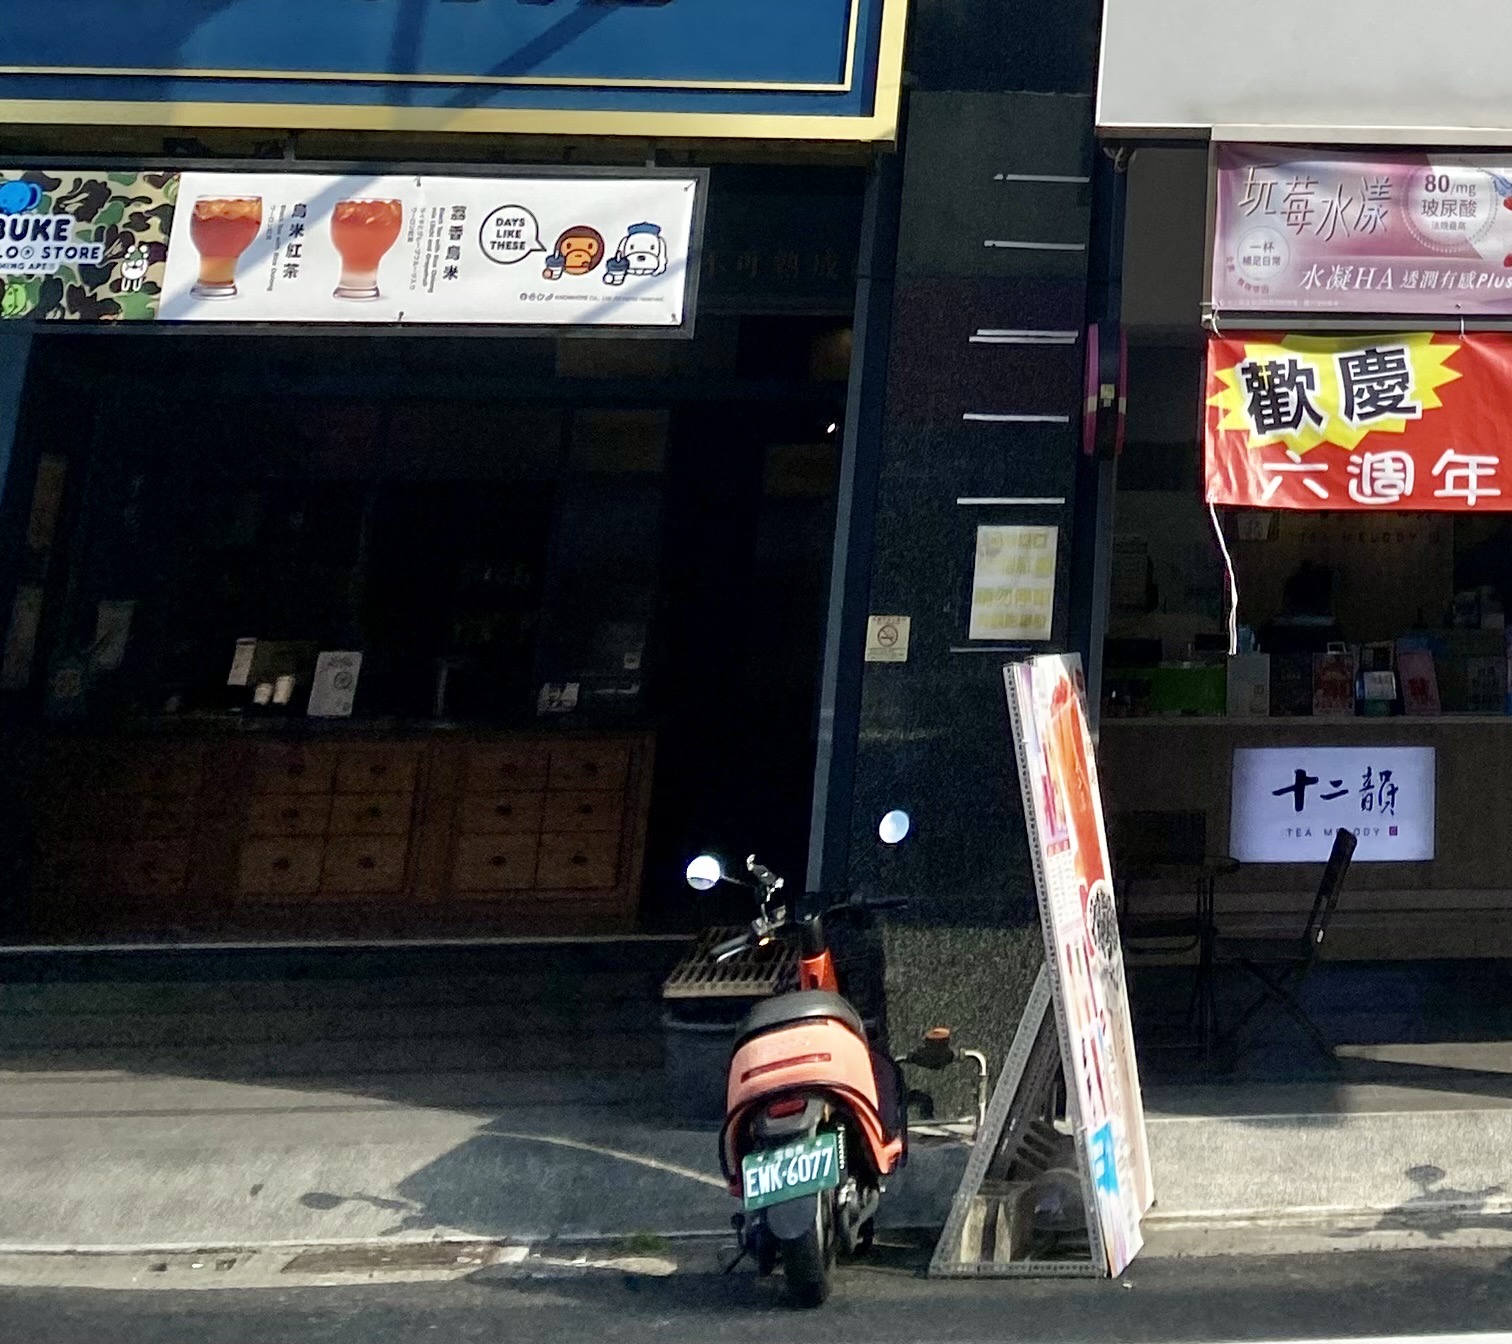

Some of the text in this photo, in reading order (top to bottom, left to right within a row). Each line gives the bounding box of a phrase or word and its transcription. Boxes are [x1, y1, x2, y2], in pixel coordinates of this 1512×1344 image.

[1425, 175, 1476, 197] 80/mg
[1421, 199, 1477, 219] 玻尿酸
[495, 217, 525, 227] DAYS
[496, 229, 522, 239] LIKE
[41, 246, 100, 259] STORE
[490, 241, 526, 251] THESE
[1301, 264, 1394, 291] 水凝HA
[1241, 346, 1418, 435] 歡慶
[1262, 449, 1501, 507] 六週年
[1272, 766, 1399, 816] 十二韻
[1287, 828, 1312, 837] TEA
[1324, 828, 1380, 837] MODY
